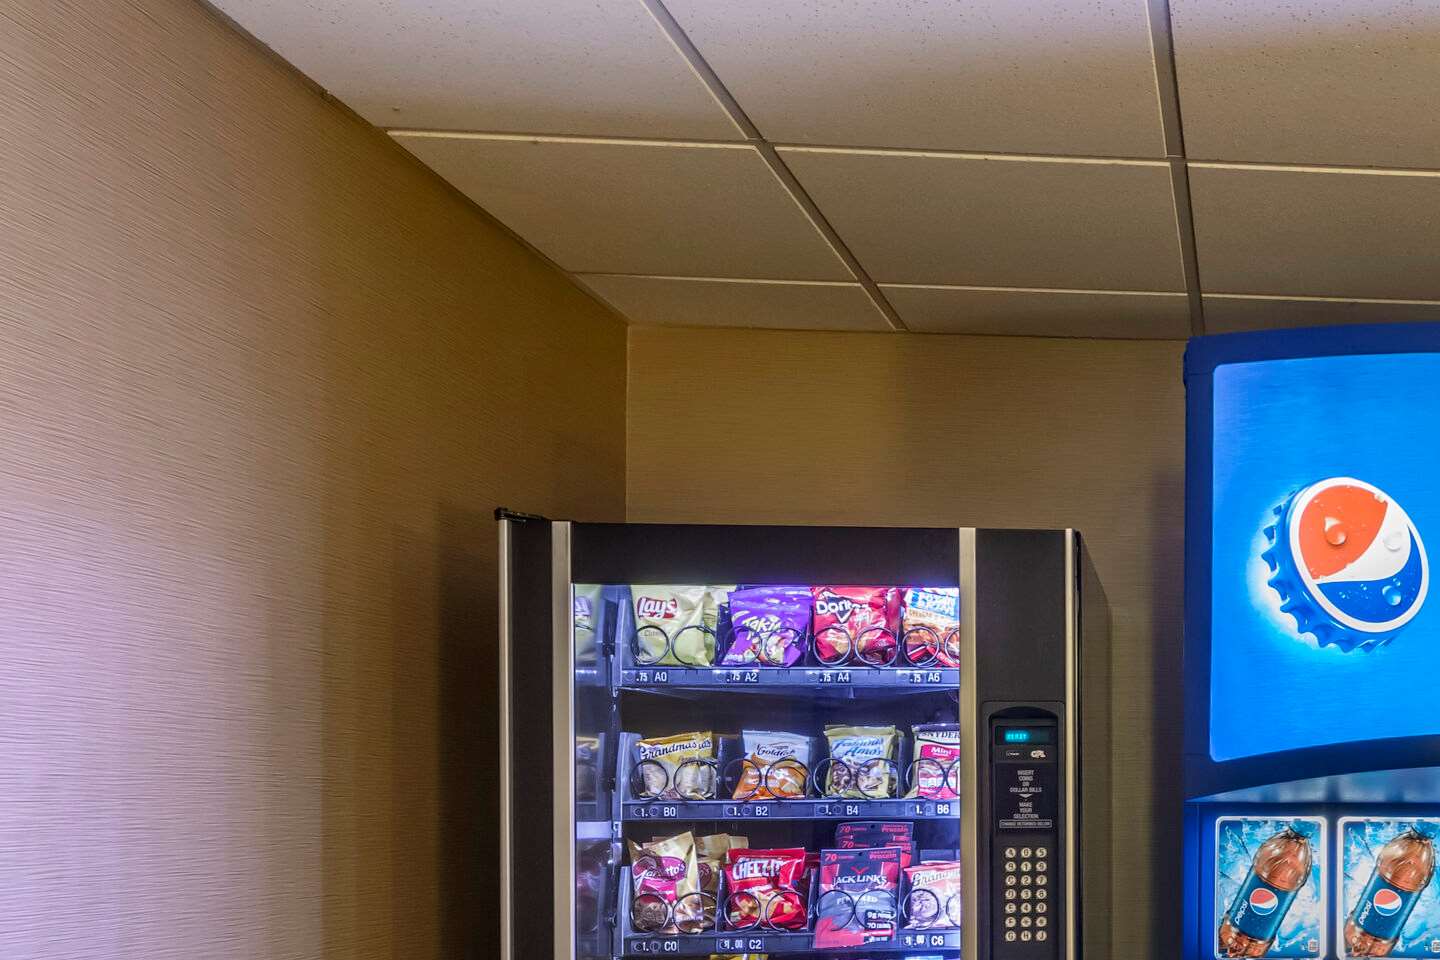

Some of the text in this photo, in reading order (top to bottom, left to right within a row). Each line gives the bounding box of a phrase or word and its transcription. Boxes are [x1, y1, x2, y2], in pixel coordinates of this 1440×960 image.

[655, 671, 667, 682] A0
[745, 671, 757, 682] A2
[837, 672, 849, 682] A4
[928, 672, 940, 682] A6
[834, 738, 884, 749] Famous
[844, 747, 882, 757] Amos
[931, 747, 951, 756] Mini
[756, 806, 768, 816] B2
[847, 805, 859, 815] B4
[937, 804, 949, 814] B6
[825, 853, 837, 861] 70
[833, 876, 855, 888] JACK
[749, 939, 761, 949] C2
[931, 935, 943, 945] C6
